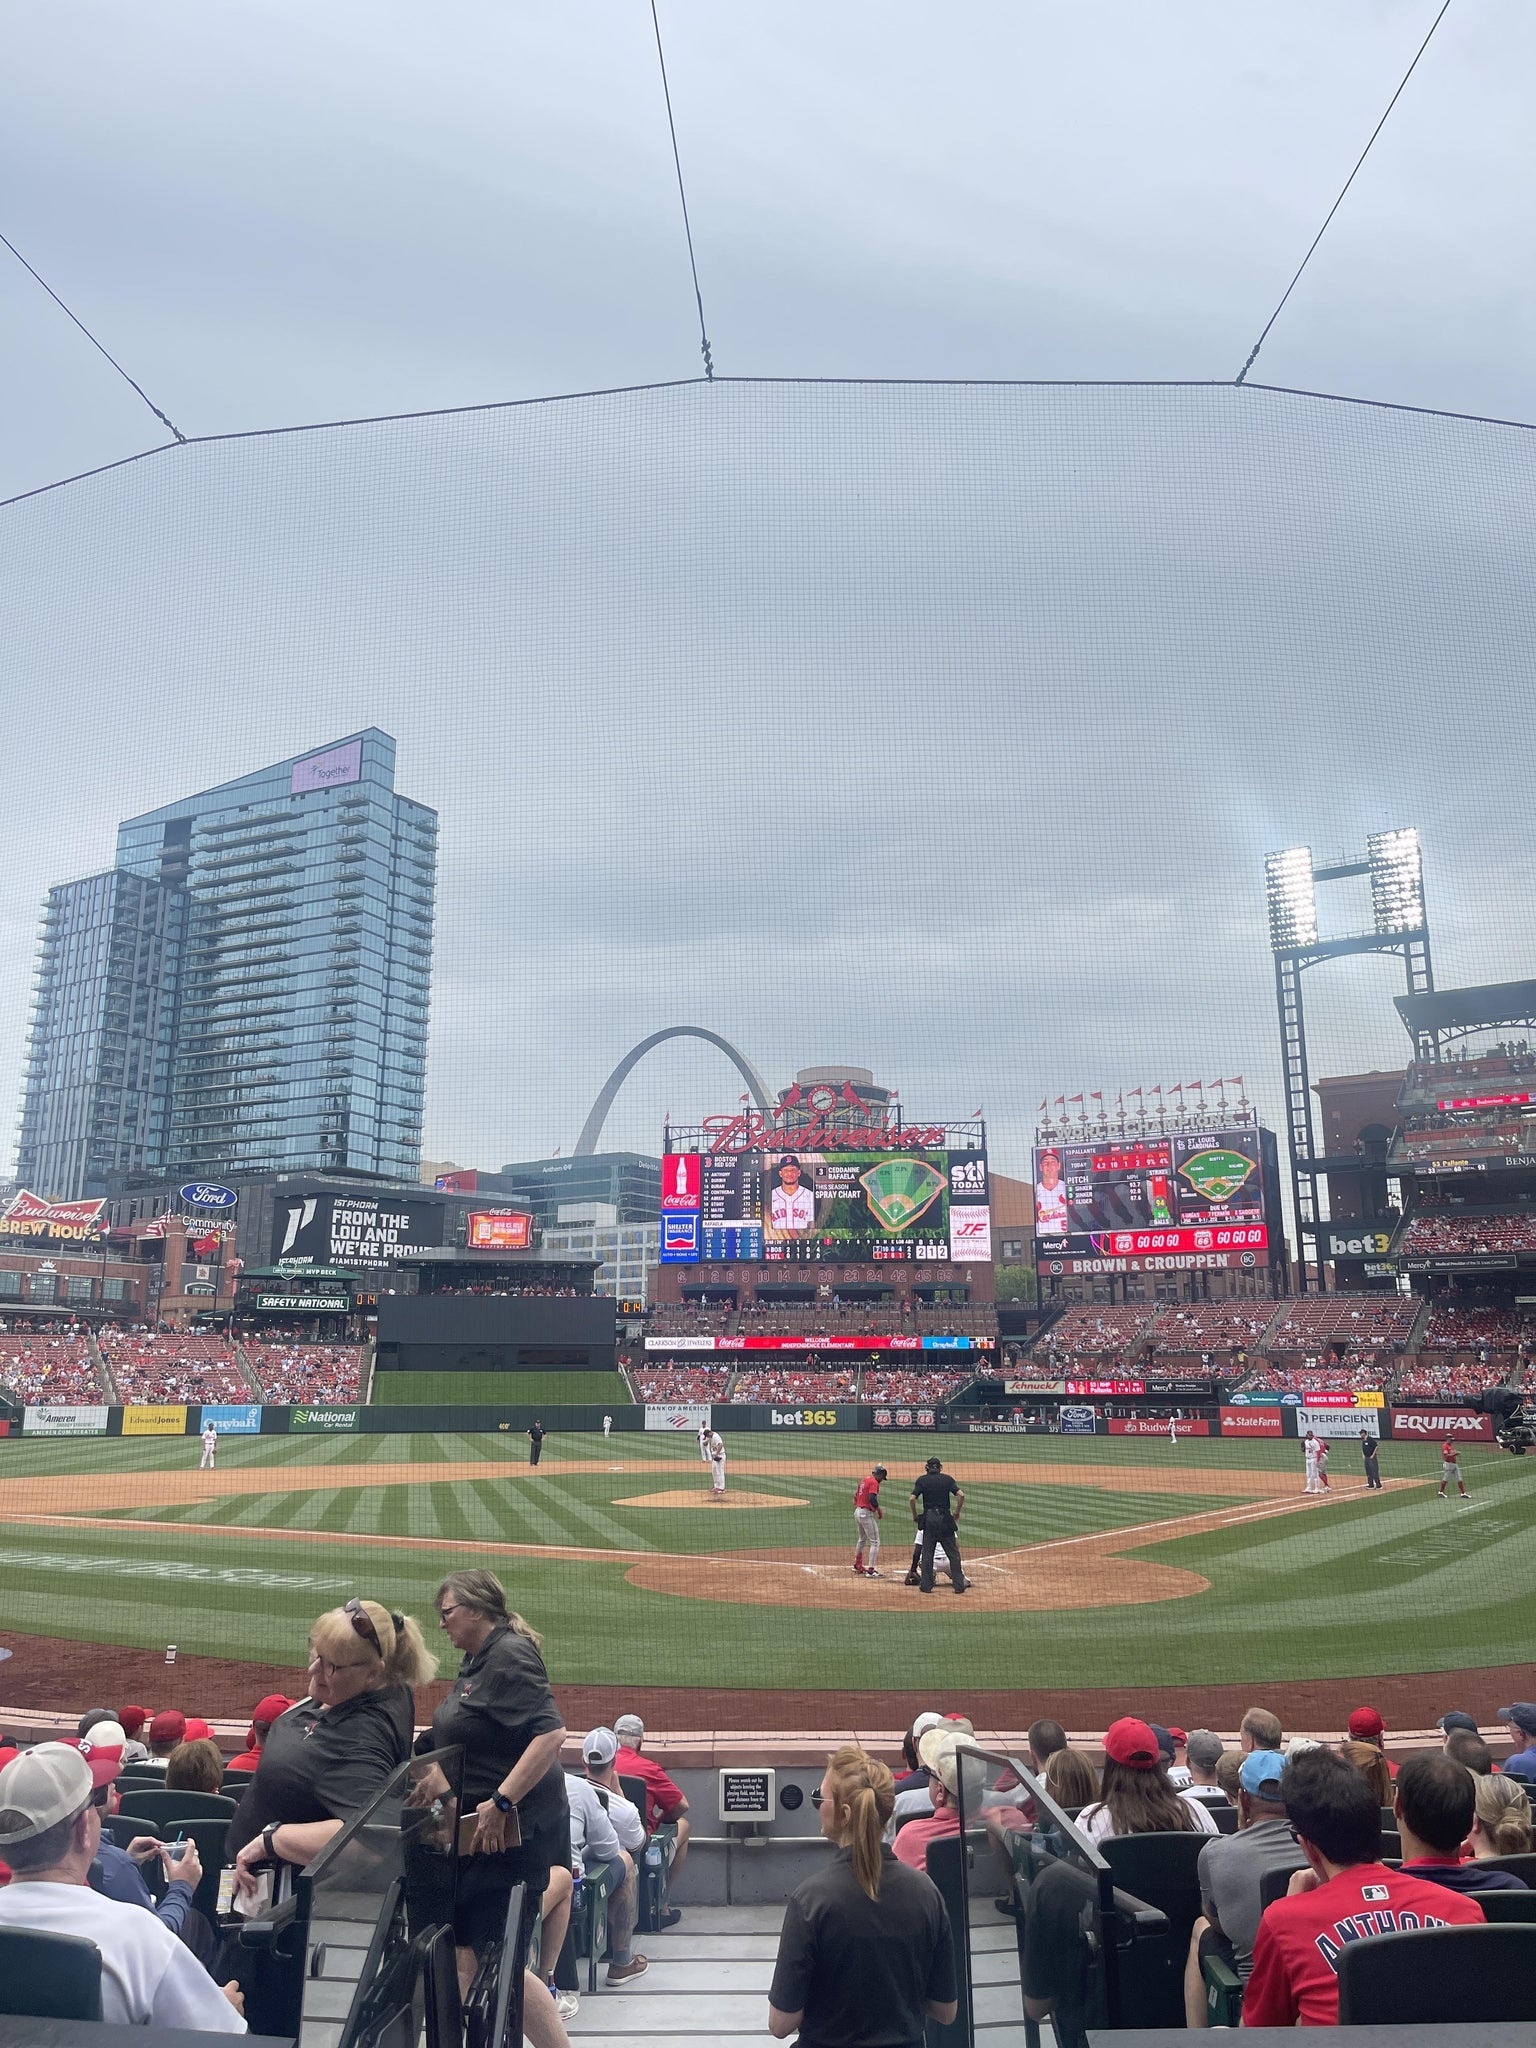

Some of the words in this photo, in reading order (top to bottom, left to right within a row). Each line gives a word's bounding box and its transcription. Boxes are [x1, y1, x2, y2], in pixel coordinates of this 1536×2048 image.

[318, 765, 351, 780] Together
[702, 1114, 946, 1153] Budweiser
[1054, 1126, 1121, 1140] WORLD
[1122, 1112, 1236, 1133] CHAMPIONS
[192, 1185, 227, 1204] Ford
[815, 1191, 837, 1199] SPRAY
[3, 1198, 102, 1222] Budweiser
[347, 1200, 378, 1210] PHORM
[182, 1216, 235, 1232] Community
[332, 1209, 377, 1226] FROM
[380, 1214, 410, 1229] THE
[0, 1220, 46, 1236] BREW
[331, 1225, 361, 1240] LOU
[364, 1228, 398, 1243] AND
[1137, 1236, 1150, 1248] GO
[1152, 1235, 1164, 1247] GO
[1166, 1234, 1179, 1246] GO
[1218, 1232, 1230, 1244] GO
[1232, 1231, 1245, 1243] GO
[1248, 1230, 1261, 1242] GO
[330, 1240, 379, 1257] WE'RE
[919, 1248, 924, 1256] 2
[940, 1248, 945, 1256] 2
[329, 1258, 389, 1267] #IAM1STPHORM
[1073, 1258, 1126, 1273] BROWN
[1132, 1261, 1140, 1270] &
[1145, 1254, 1228, 1270] CROUPPEN
[1407, 1262, 1426, 1272] Mercy
[711, 1270, 720, 1283] 2
[726, 1270, 734, 1282] 6
[742, 1270, 750, 1282] 9
[757, 1270, 770, 1282] 10
[778, 1270, 790, 1282] 14
[798, 1270, 810, 1282] 17
[818, 1270, 834, 1282] 20
[844, 1270, 859, 1282] 23
[867, 1270, 882, 1282] 24
[890, 1270, 907, 1282] 42
[915, 1270, 931, 1282] 45
[262, 1297, 297, 1306] SAFETY
[298, 1299, 345, 1308] NATIONAL
[719, 1338, 745, 1347] Coca-Cola
[890, 1338, 918, 1348] Coca-Cola
[45, 1415, 76, 1423] Ameren
[308, 1411, 355, 1422] National
[772, 1409, 837, 1425] bet365
[1067, 1408, 1087, 1418] Ford
[1312, 1415, 1376, 1423] PERFICIENT
[1394, 1415, 1483, 1433] EQUIFAX
